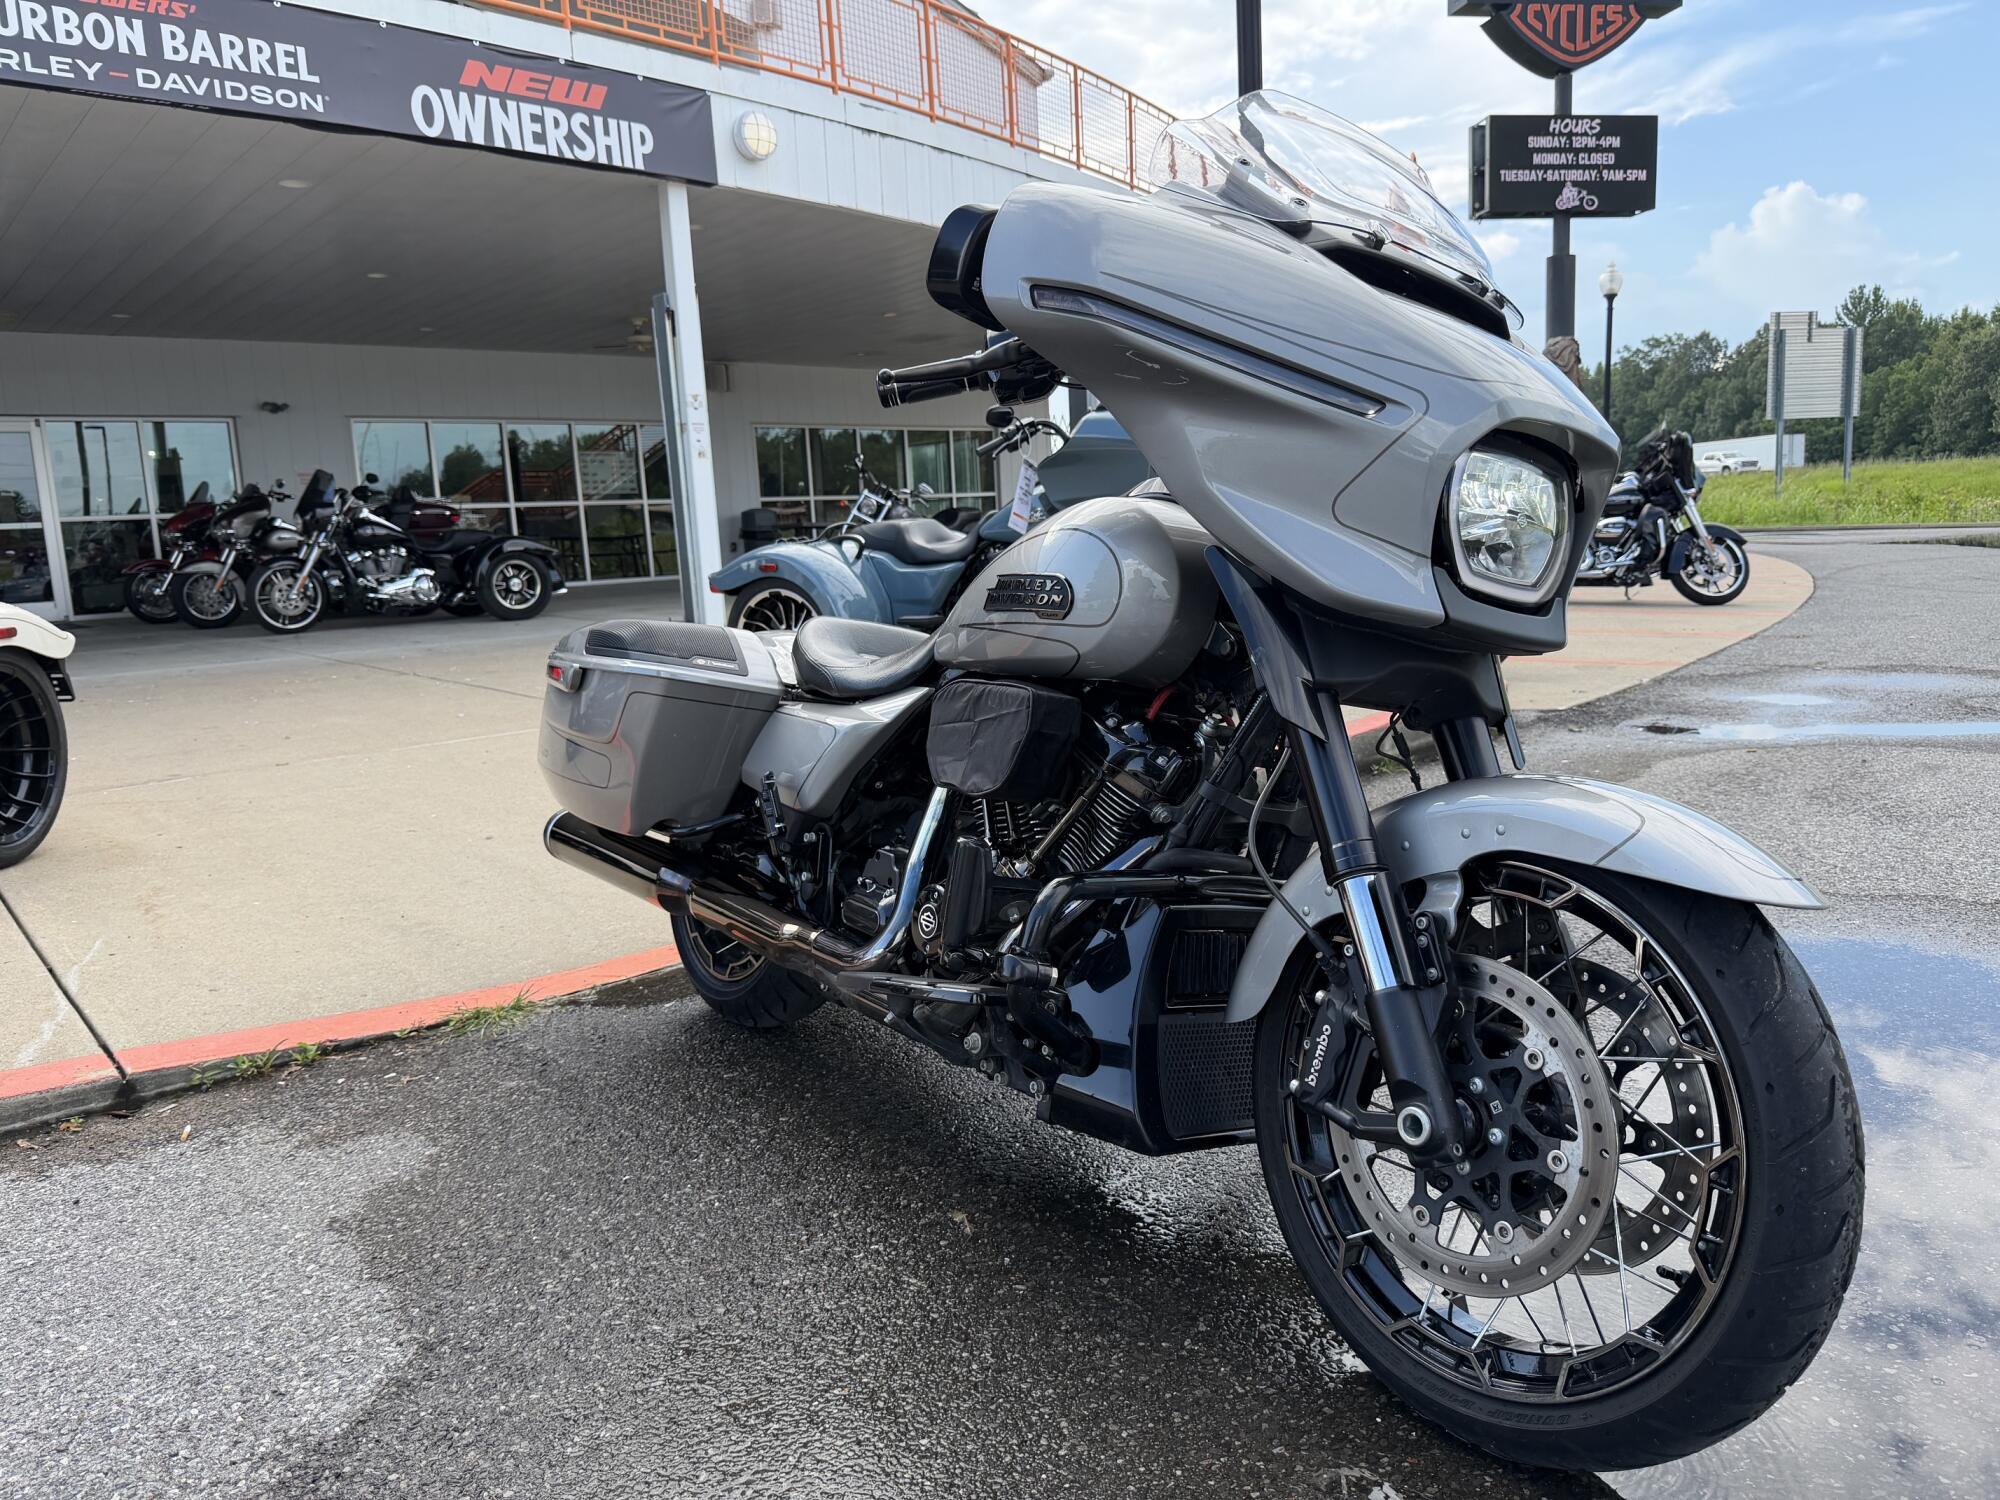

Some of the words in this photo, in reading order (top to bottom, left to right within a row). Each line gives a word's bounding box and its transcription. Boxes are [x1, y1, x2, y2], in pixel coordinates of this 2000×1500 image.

[1527, 3, 1623, 51] CYCLES
[160, 23, 321, 84] BARREL
[136, 67, 325, 113] DAVIDSON
[459, 59, 608, 110] NEW
[410, 84, 654, 170] OWNERSHIP
[1528, 136, 1570, 149] SUNDAY:
[1572, 136, 1621, 149] 12PM-4PM
[1549, 118, 1602, 135] HOURS
[1533, 153, 1577, 165] MONDAY:
[1578, 153, 1616, 165] CLOSED
[1602, 169, 1648, 182] 9AM-5PM
[1304, 1024, 1332, 1087] brembo
